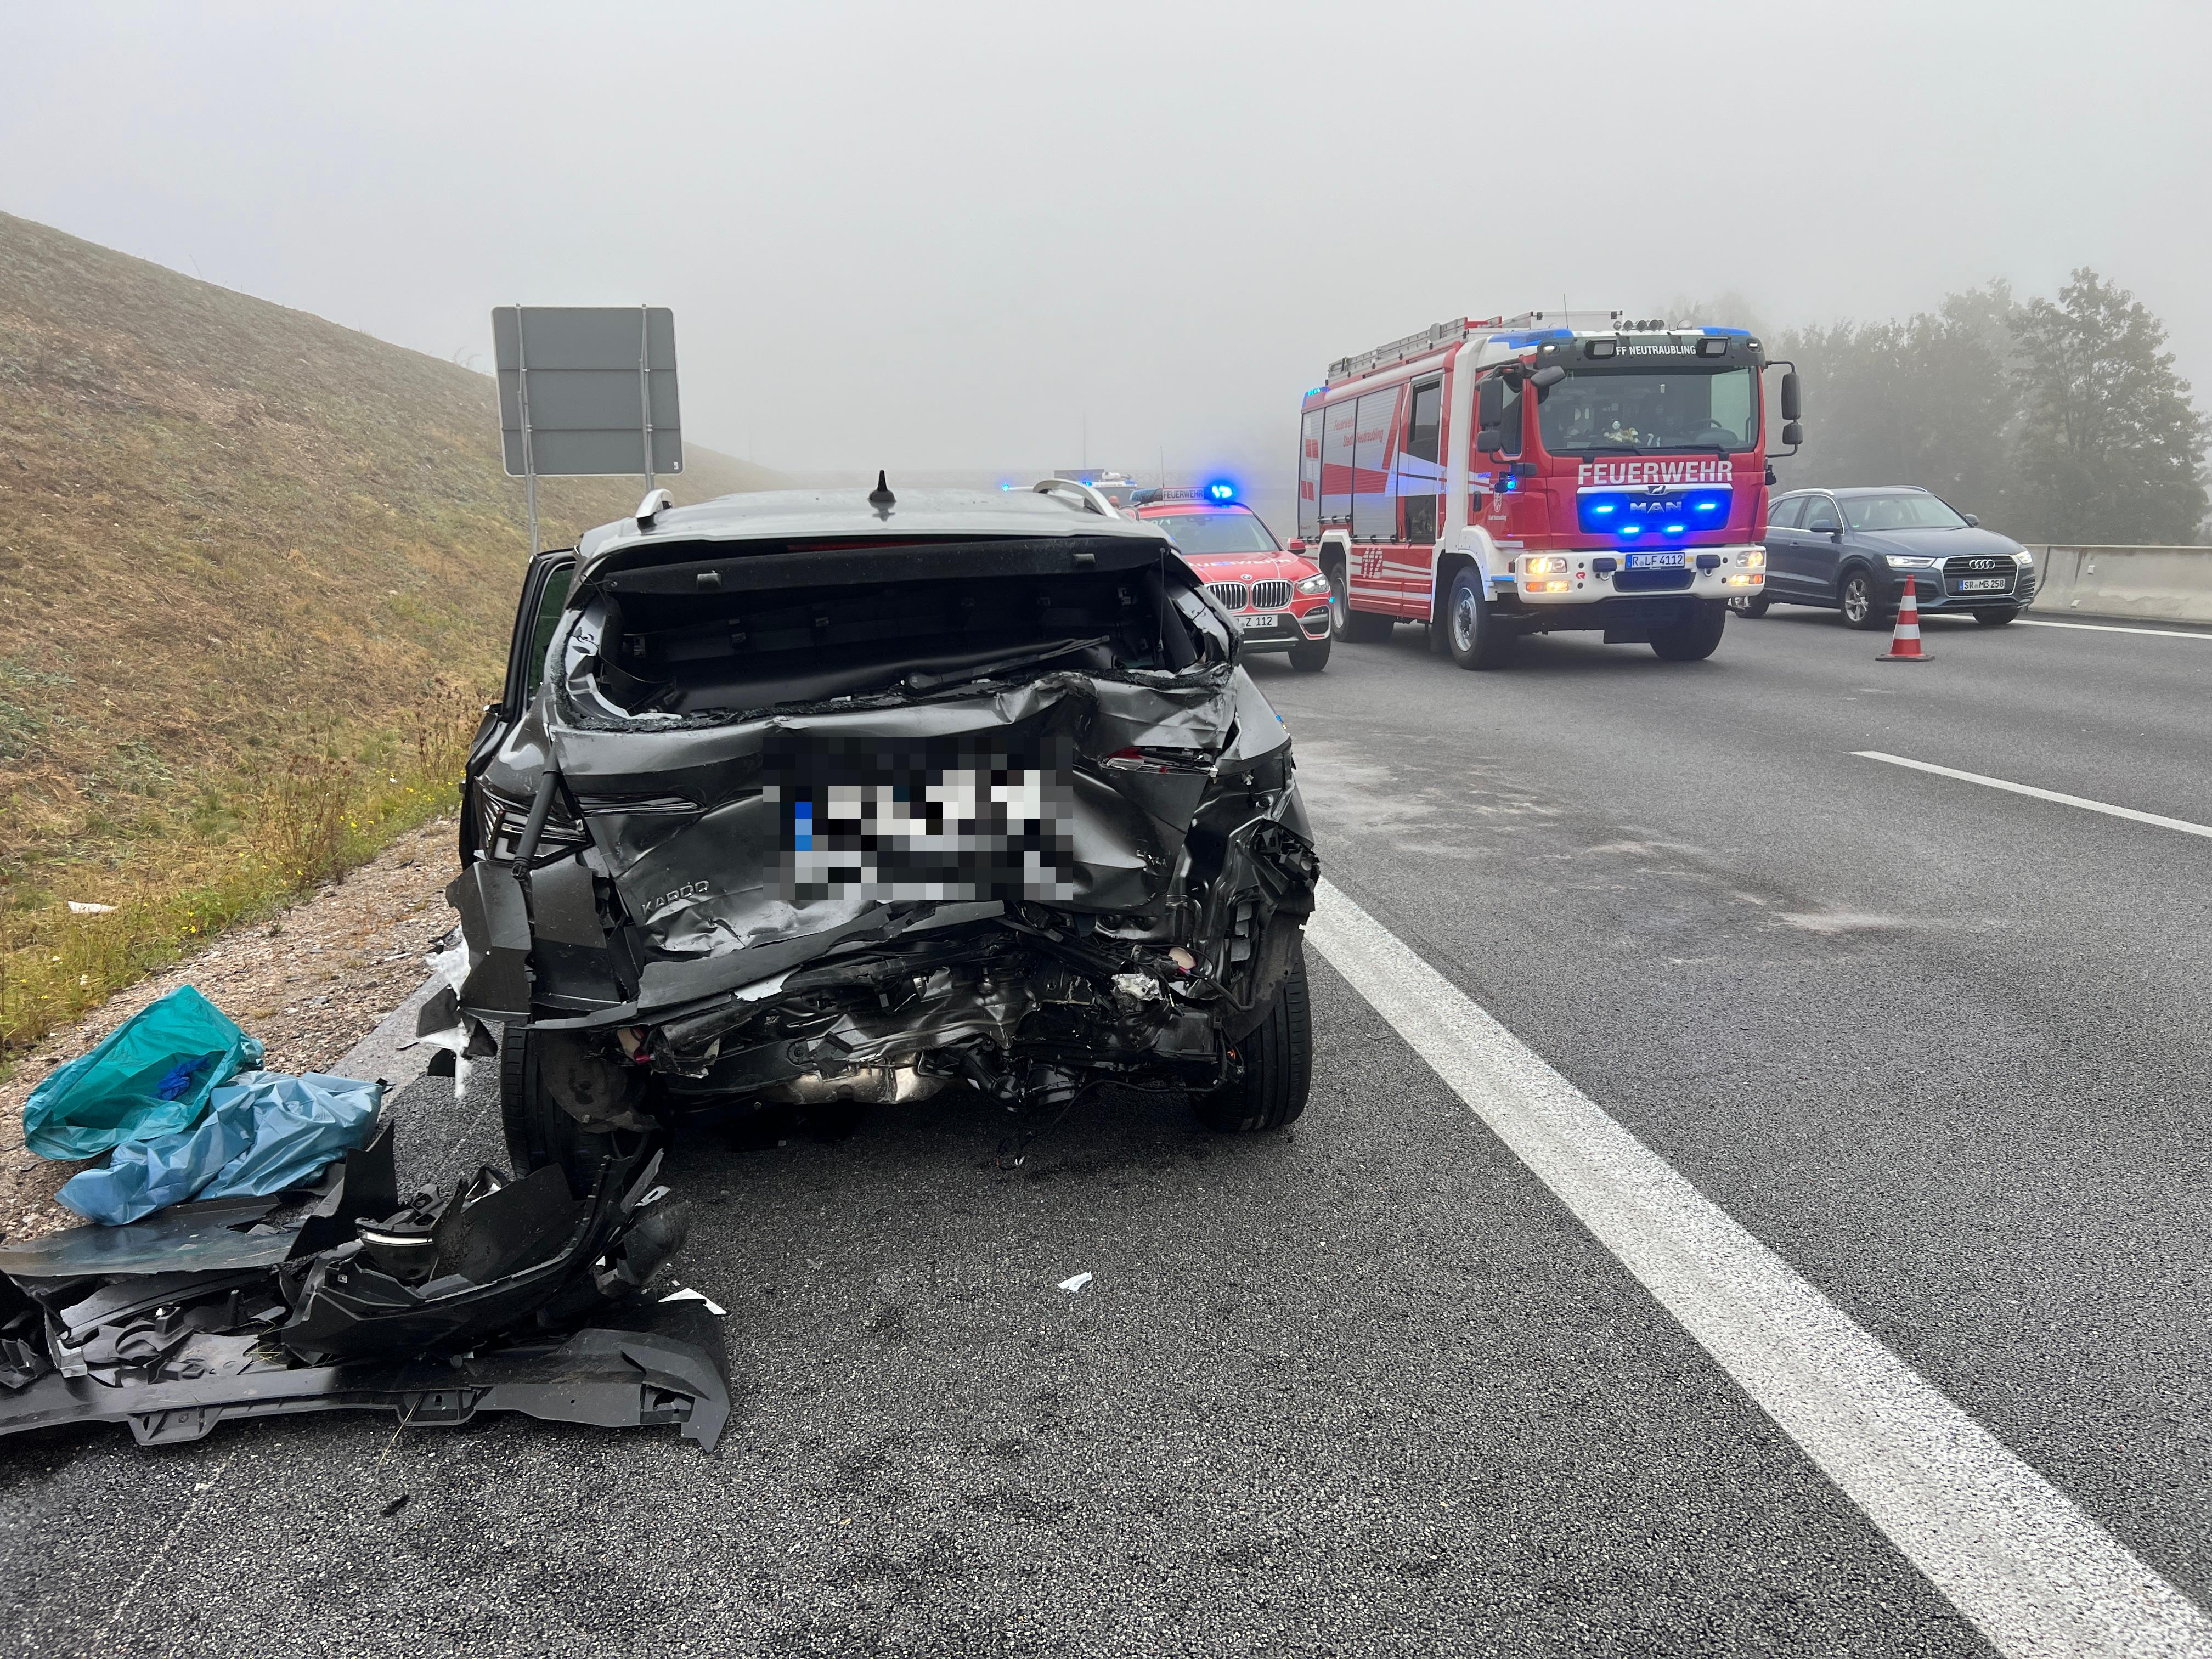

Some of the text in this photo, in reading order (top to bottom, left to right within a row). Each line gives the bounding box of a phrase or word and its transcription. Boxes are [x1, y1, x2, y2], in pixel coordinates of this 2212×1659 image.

[1616, 345, 1696, 356] FF NEUTRAUBLING
[1578, 460, 1733, 484] FEUERWEHR
[1163, 489, 1203, 499] FEUERWEHR
[1630, 501, 1682, 514] MAN
[1632, 555, 1683, 566] R LF 4112
[1964, 581, 1974, 589] SR
[1990, 580, 2004, 588] 258
[1245, 618, 1251, 627] Z
[1256, 616, 1272, 626] 112
